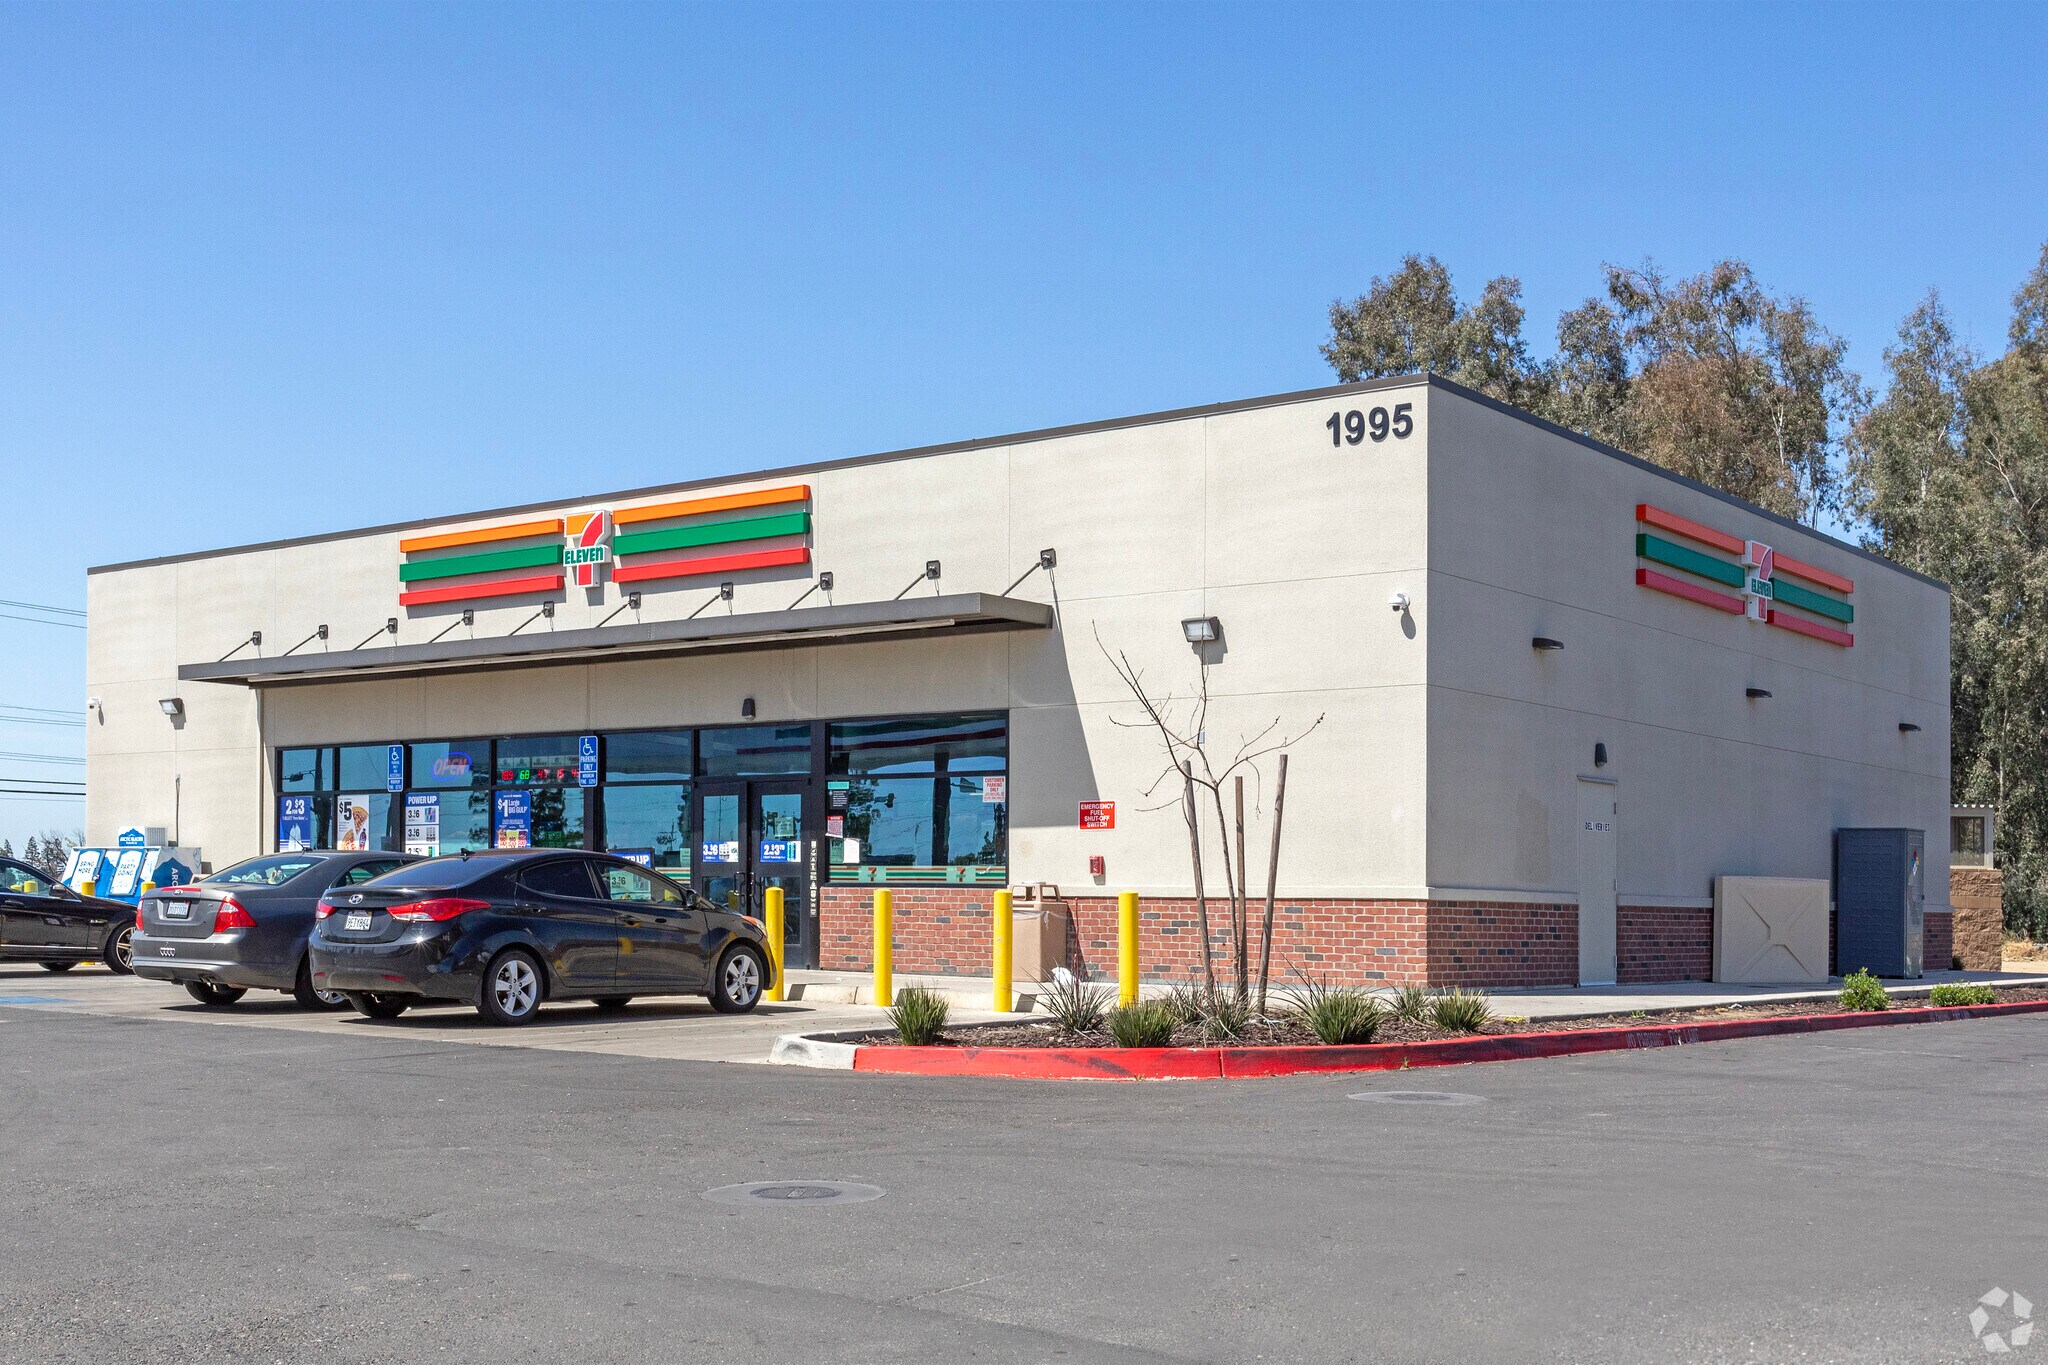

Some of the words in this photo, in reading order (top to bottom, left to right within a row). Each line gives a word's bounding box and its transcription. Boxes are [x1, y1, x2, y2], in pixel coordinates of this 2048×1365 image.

[1326, 402, 1414, 447] 1995
[434, 758, 467, 776] OPEN
[285, 799, 292, 815] 2
[294, 798, 305, 815] $3
[408, 796, 427, 804] POWER
[426, 795, 437, 804] UP
[497, 798, 508, 817] $1
[339, 801, 352, 821] $5
[1585, 821, 1610, 832] DELIVERIES
[117, 869, 134, 877] GOING
